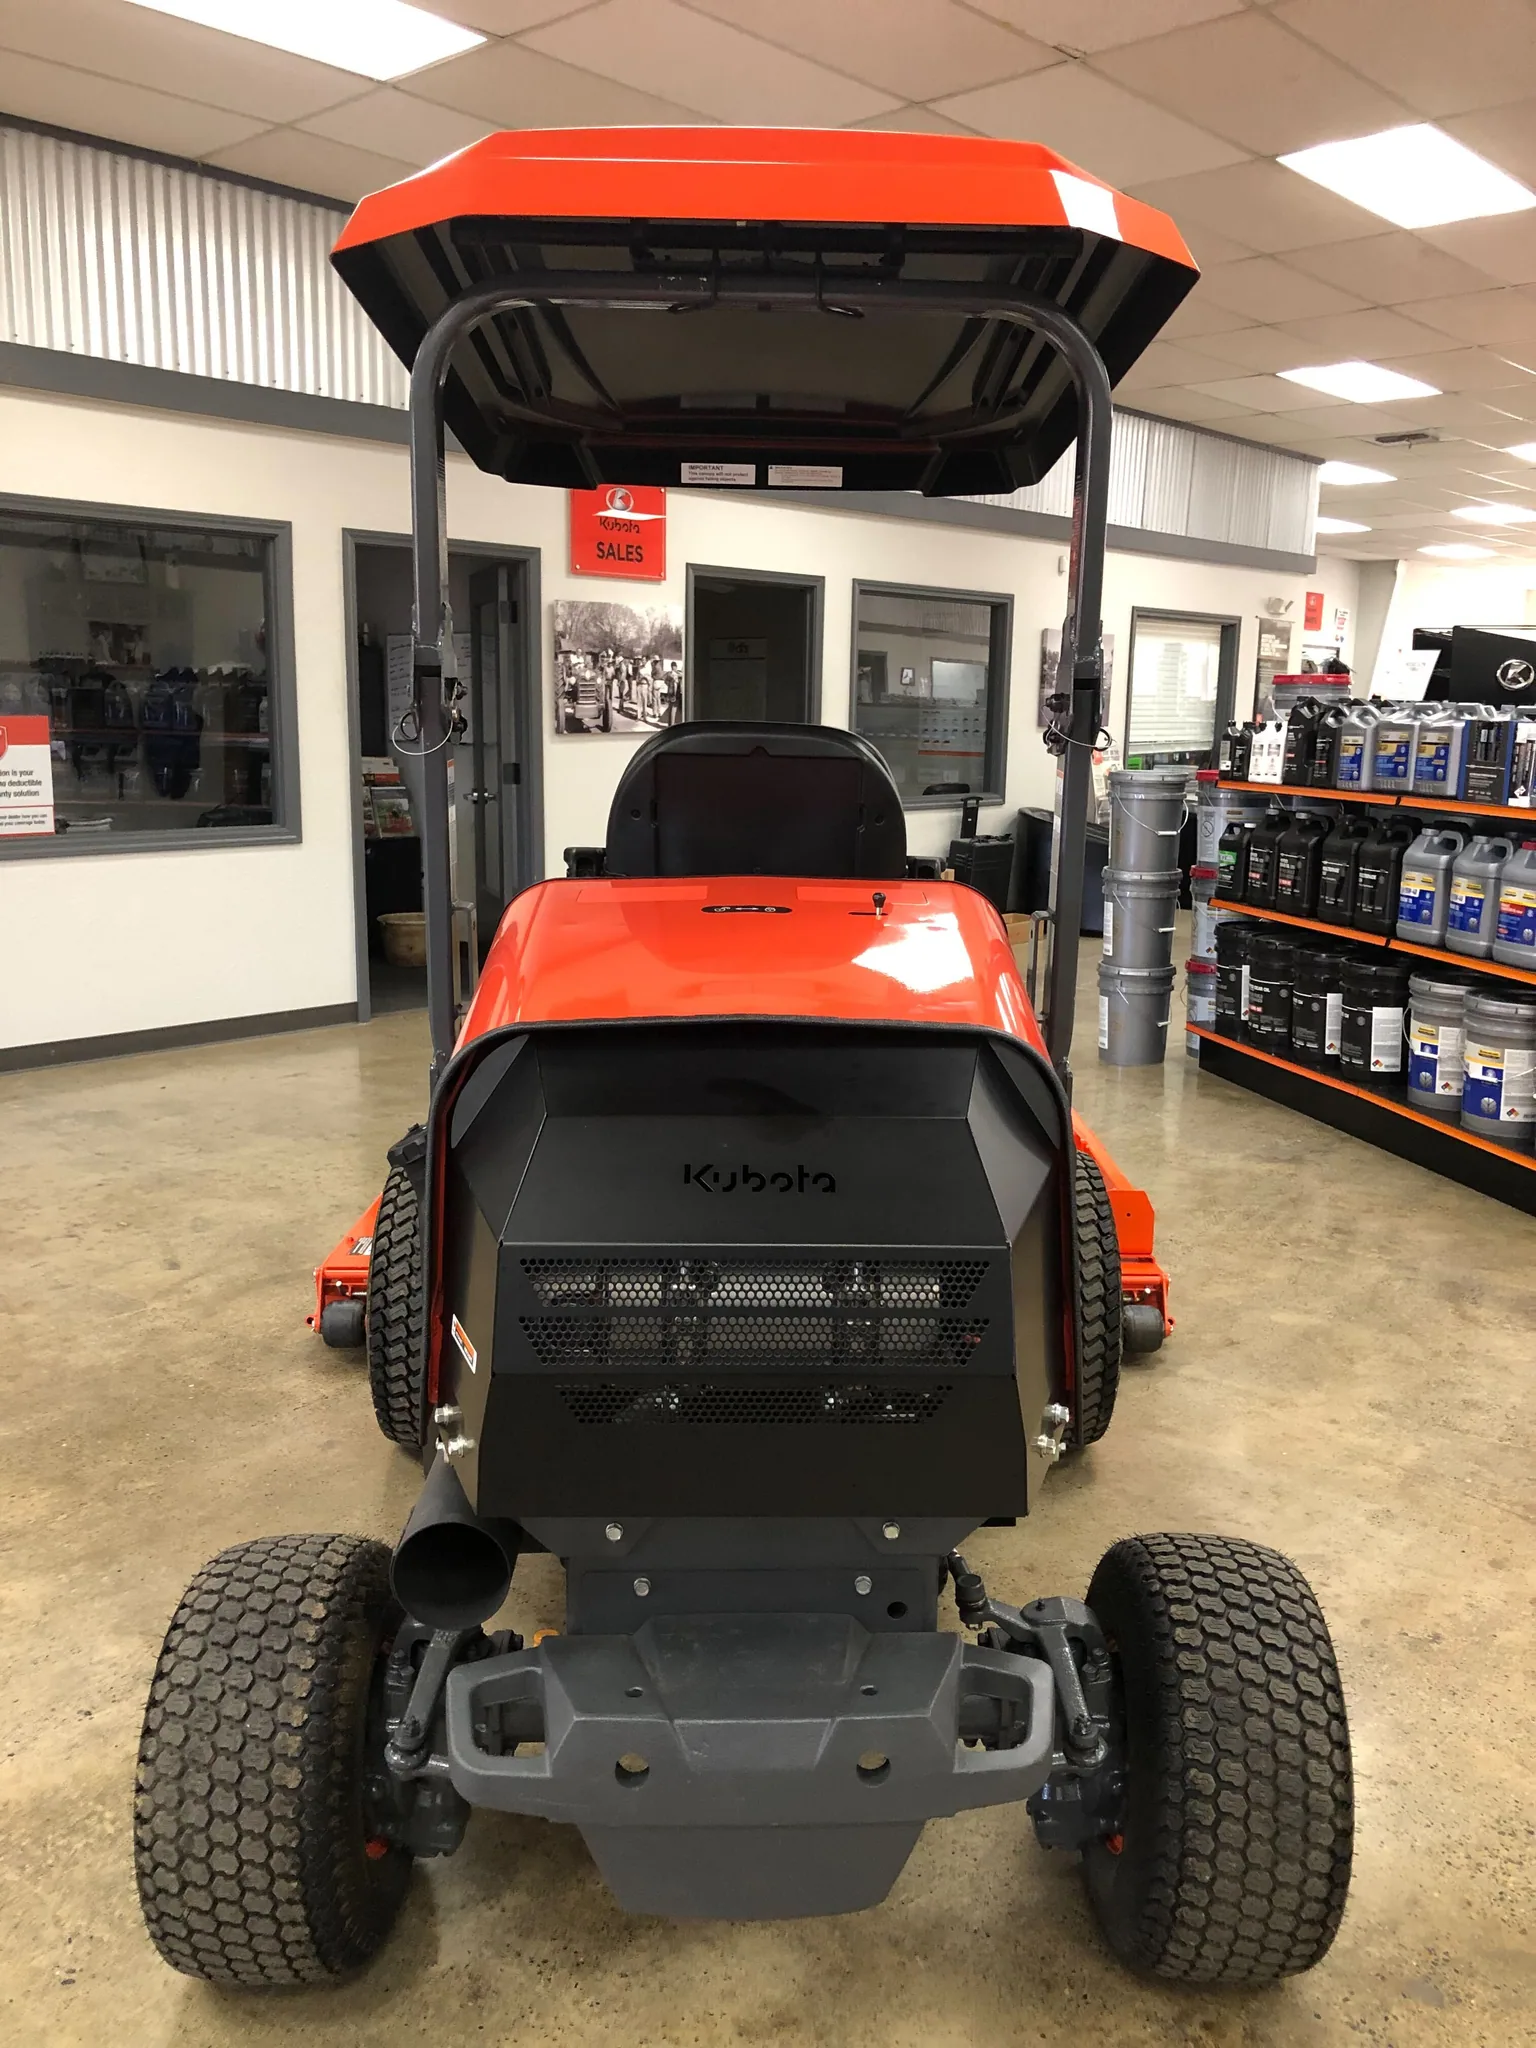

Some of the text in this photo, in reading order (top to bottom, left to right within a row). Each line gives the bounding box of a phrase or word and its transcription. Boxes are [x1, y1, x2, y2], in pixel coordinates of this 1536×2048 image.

[599, 516, 640, 534] Kubota
[596, 541, 644, 563] SALES
[8, 779, 42, 787] deductible
[683, 1163, 837, 1193] Kubota
